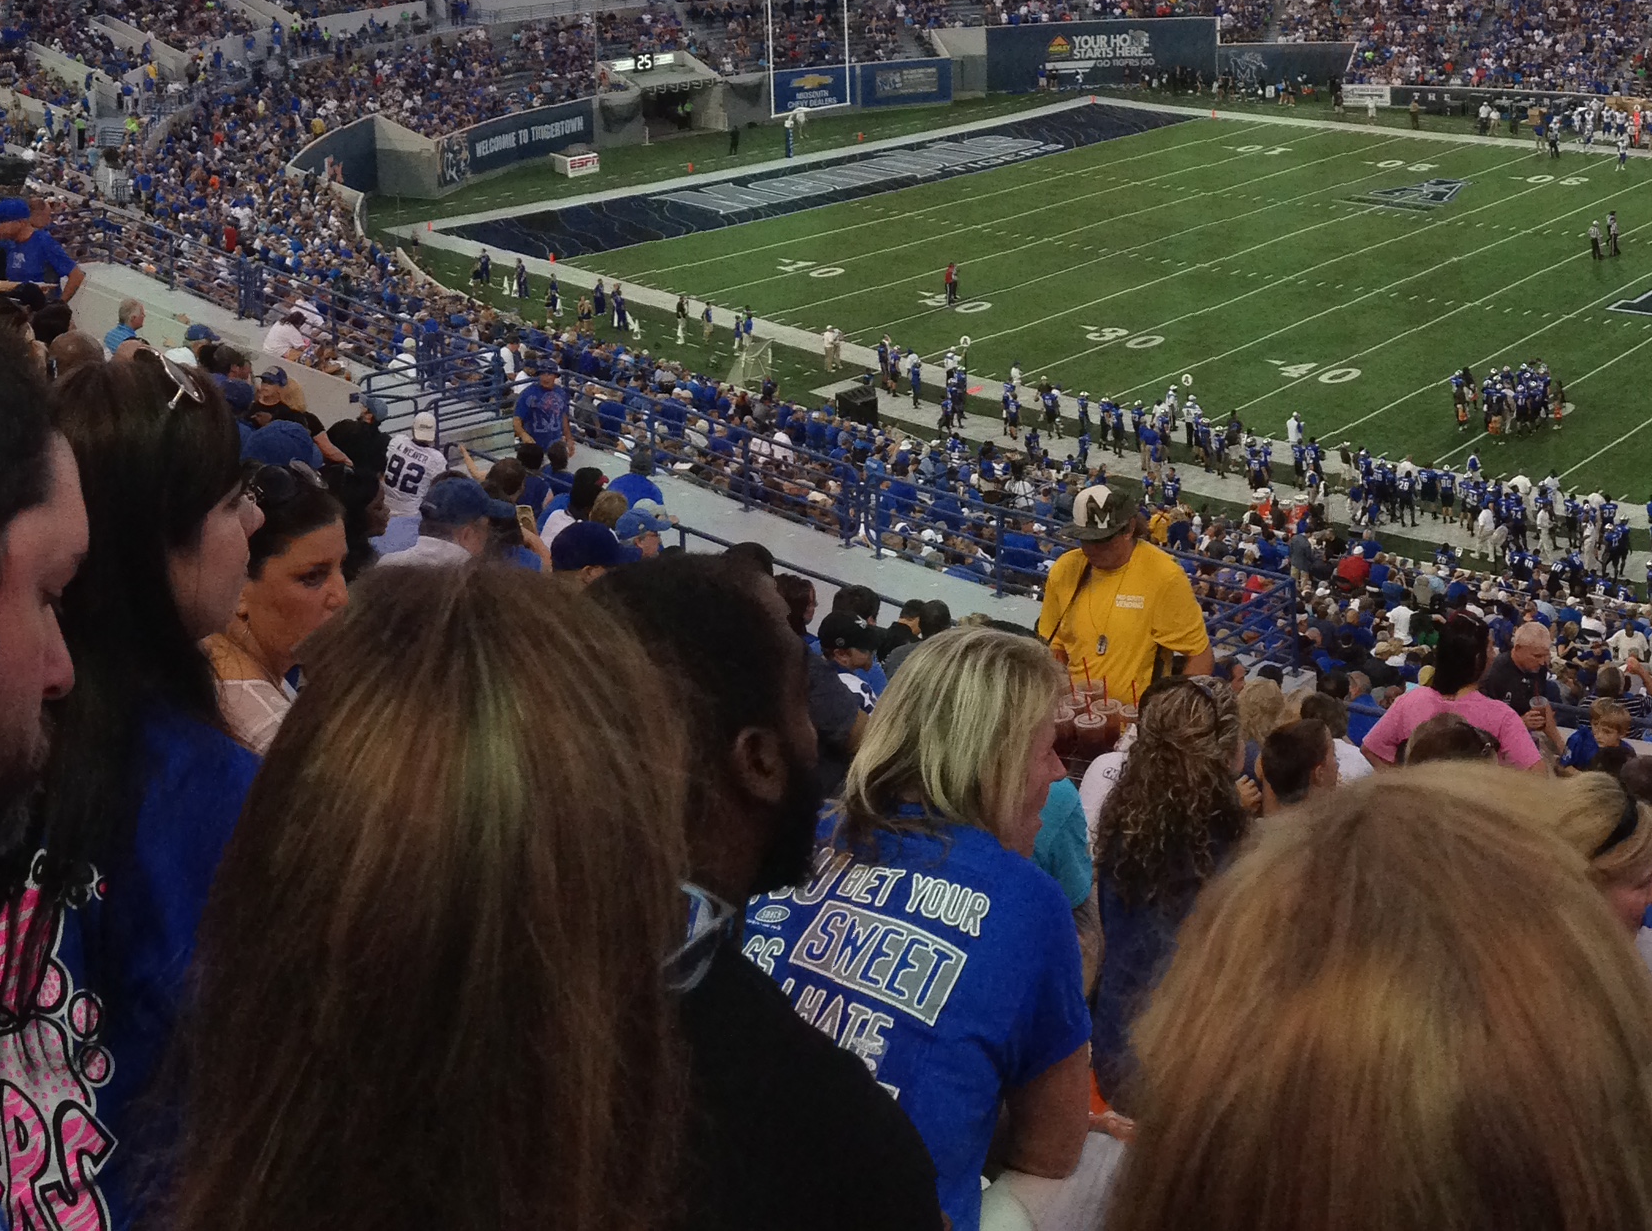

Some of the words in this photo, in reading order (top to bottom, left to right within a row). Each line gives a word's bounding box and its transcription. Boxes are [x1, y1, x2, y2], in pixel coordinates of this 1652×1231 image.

[1072, 35, 1107, 48] YOUR
[1073, 48, 1113, 59] STARTS
[637, 54, 652, 69] 25
[1140, 58, 1155, 66] GO
[809, 96, 837, 107] DEALERS
[518, 128, 529, 145] TO
[384, 454, 426, 495] 92
[1116, 600, 1145, 609] VENDING
[836, 864, 906, 907] BET
[905, 873, 990, 937] YOUR
[803, 909, 957, 1010] SWEET
